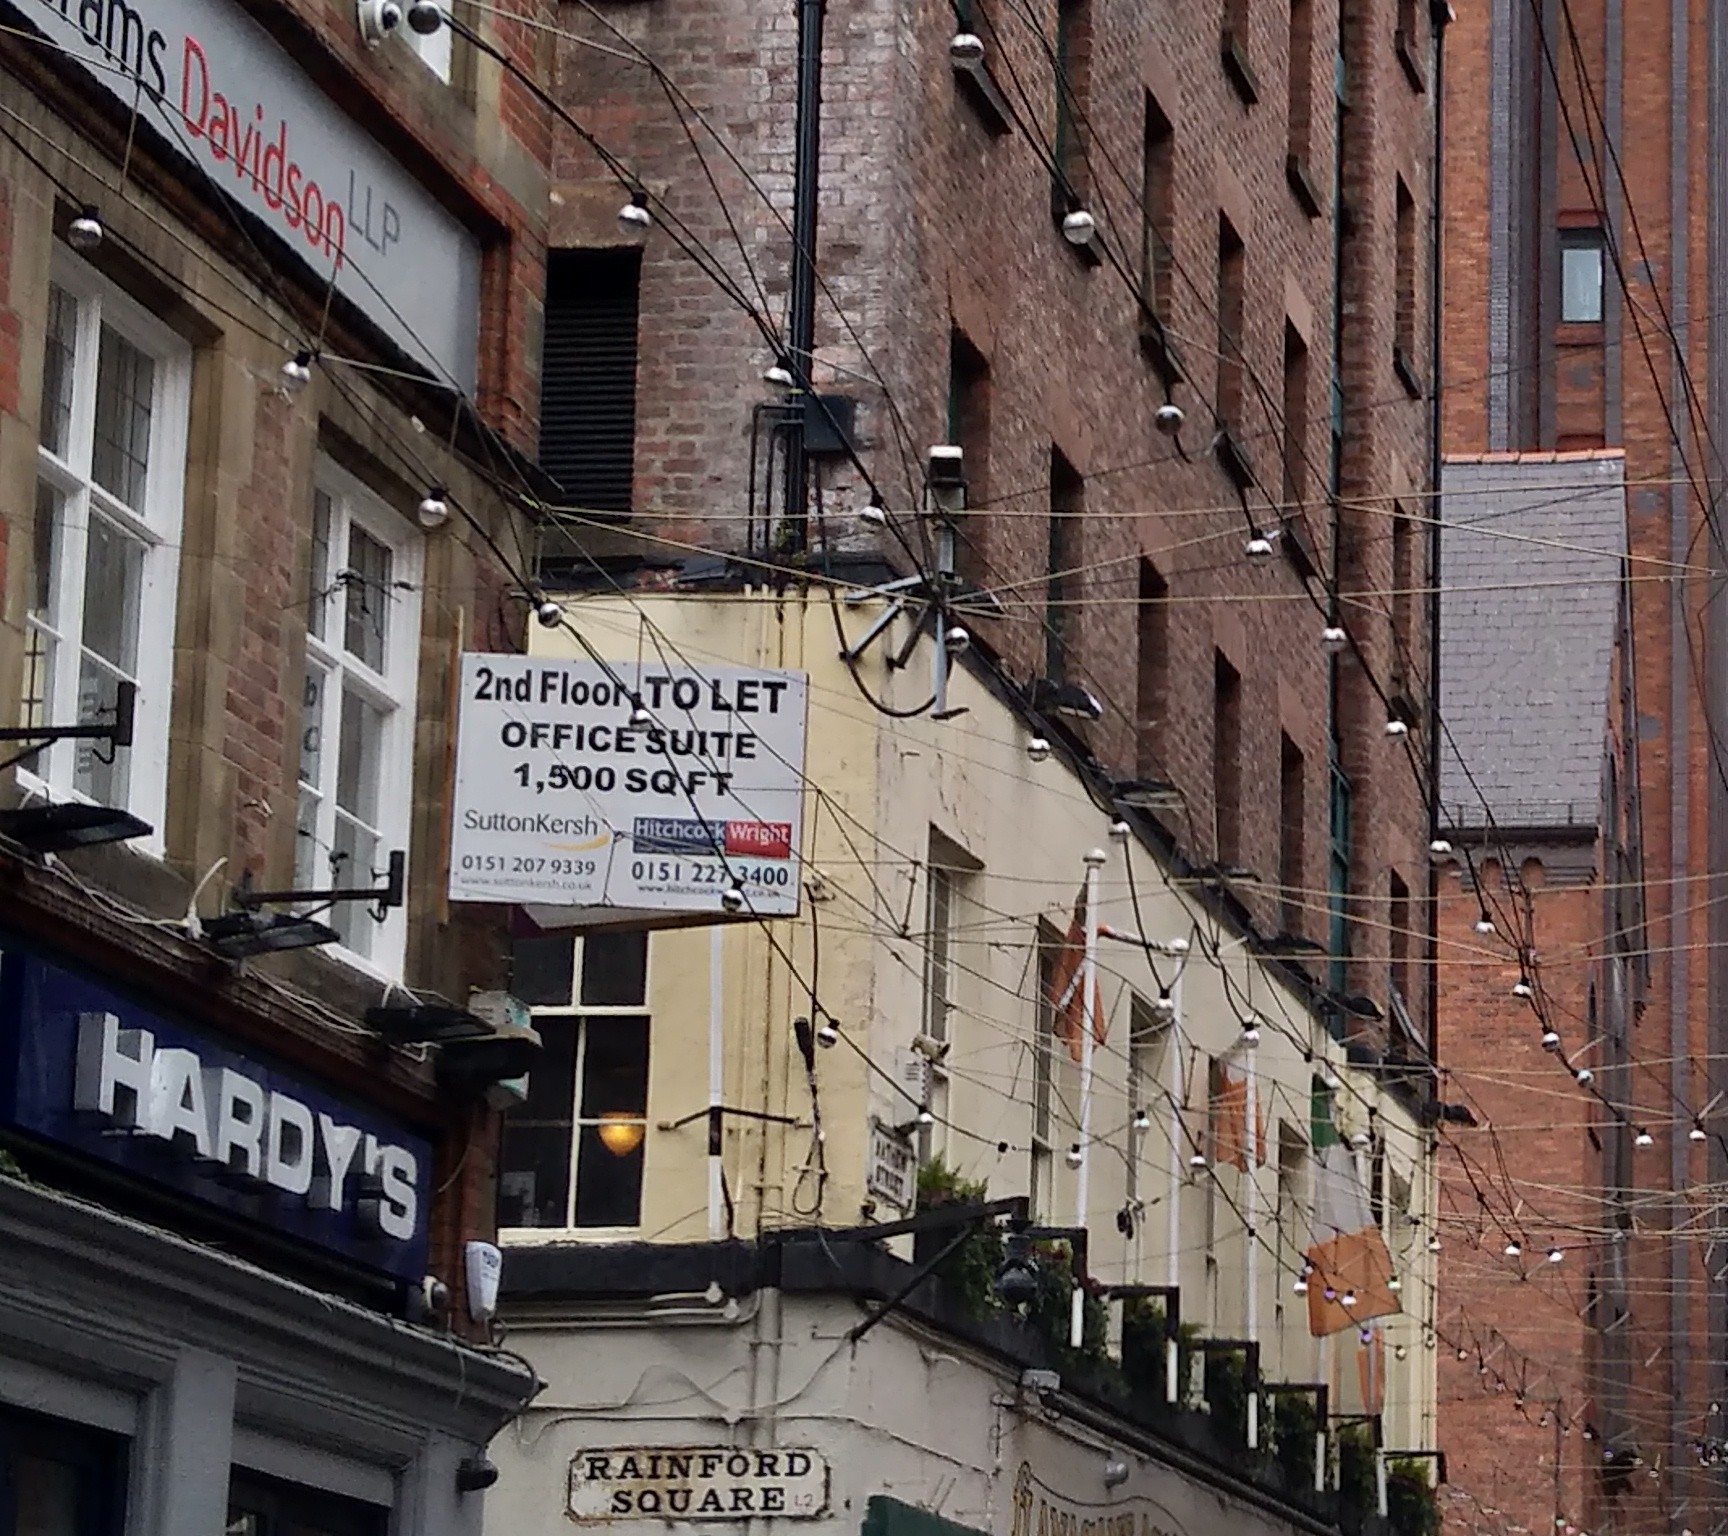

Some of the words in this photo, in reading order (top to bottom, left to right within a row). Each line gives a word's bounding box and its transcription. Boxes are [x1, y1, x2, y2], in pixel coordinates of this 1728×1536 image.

[180, 35, 345, 270] Davidson
[349, 169, 401, 256] LLP
[475, 667, 533, 703] 2nd
[540, 670, 628, 707] Floor
[645, 676, 700, 711] TO
[711, 679, 788, 714] LET
[501, 721, 636, 753] OFFICE
[646, 729, 758, 760] SUITE
[514, 763, 616, 795] 1,500
[624, 768, 678, 796] SQ
[688, 771, 734, 796] FT
[464, 809, 599, 835] SuttonKersh
[729, 823, 789, 845] Wright
[462, 854, 505, 871] 0151
[513, 857, 546, 874] 207
[550, 859, 596, 876] 9339
[632, 861, 680, 881] 0151
[692, 863, 726, 883] 227
[738, 866, 789, 886] 3400
[76, 1011, 418, 1241] HARDY'S
[585, 1452, 813, 1480] RAINFORD
[611, 1487, 785, 1513] SQUARE
